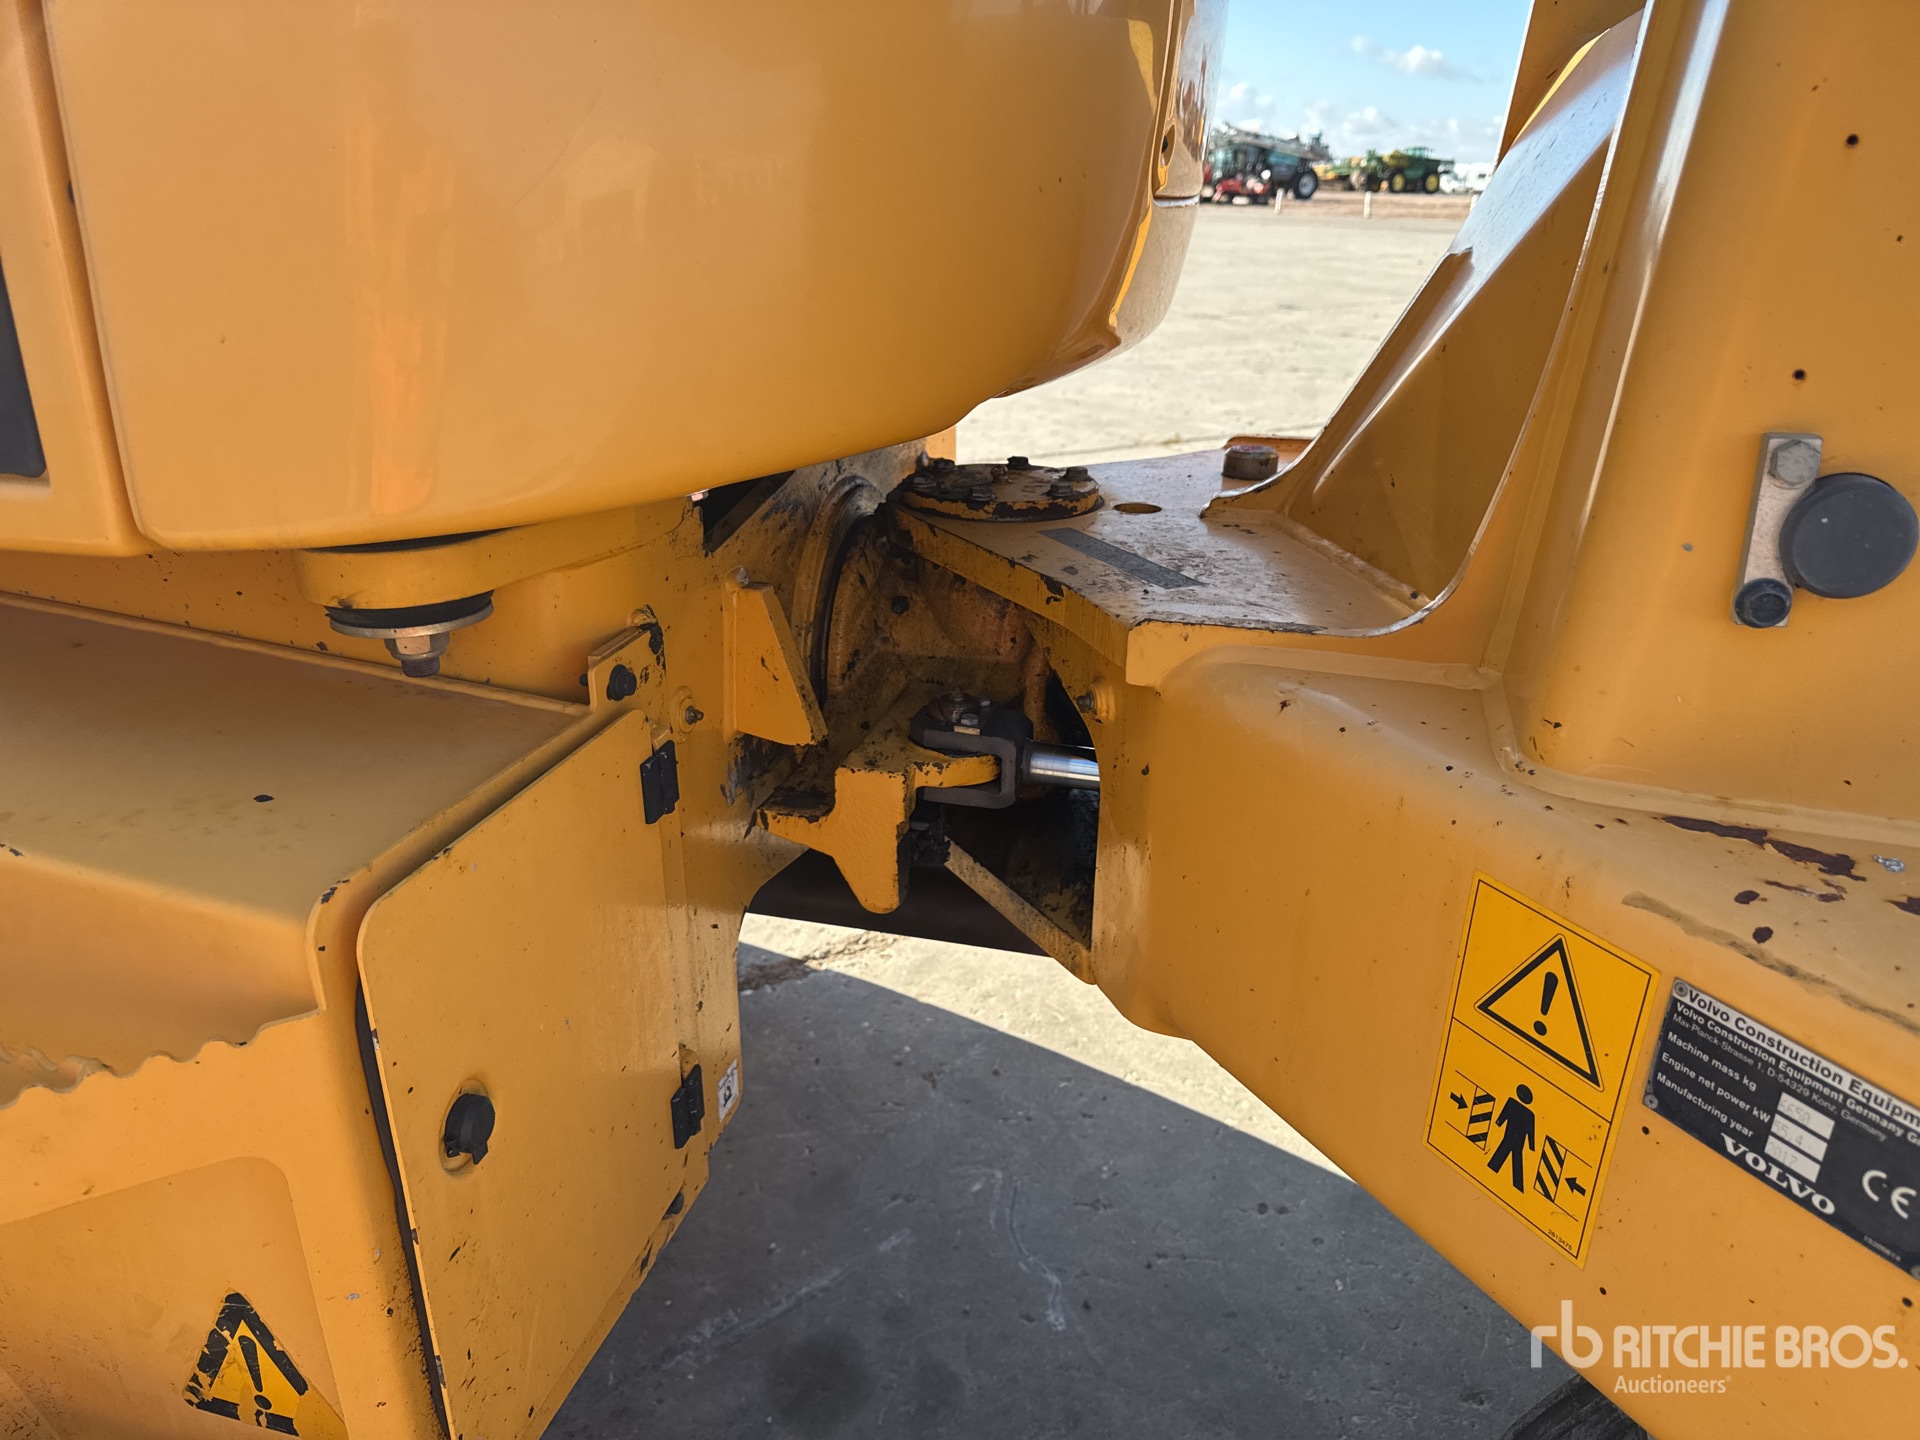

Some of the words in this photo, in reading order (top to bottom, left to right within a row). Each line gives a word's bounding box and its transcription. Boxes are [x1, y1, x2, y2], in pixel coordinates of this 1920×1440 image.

[1667, 1031, 1709, 1062] Machine
[1712, 1053, 1740, 1081] mass
[1743, 1072, 1757, 1092] kg
[1676, 1002, 1705, 1025] Volvo
[1707, 1019, 1776, 1065] Construction
[1778, 1058, 1844, 1103] Equipment
[1846, 1098, 1905, 1137] Germany
[1688, 989, 1730, 1023] Volvo
[1735, 1017, 1843, 1086] Construction
[1656, 1072, 1728, 1123] Manufacturing
[1729, 1117, 1754, 1138] year
[1662, 1051, 1696, 1079] Engine
[1698, 1072, 1716, 1091] net
[1717, 1087, 1750, 1115] power
[1752, 1103, 1771, 1123] kW
[1767, 1067, 1809, 1096] D-54329
[1841, 1109, 1887, 1142] Germany
[1720, 1132, 1836, 1215] VOLVO
